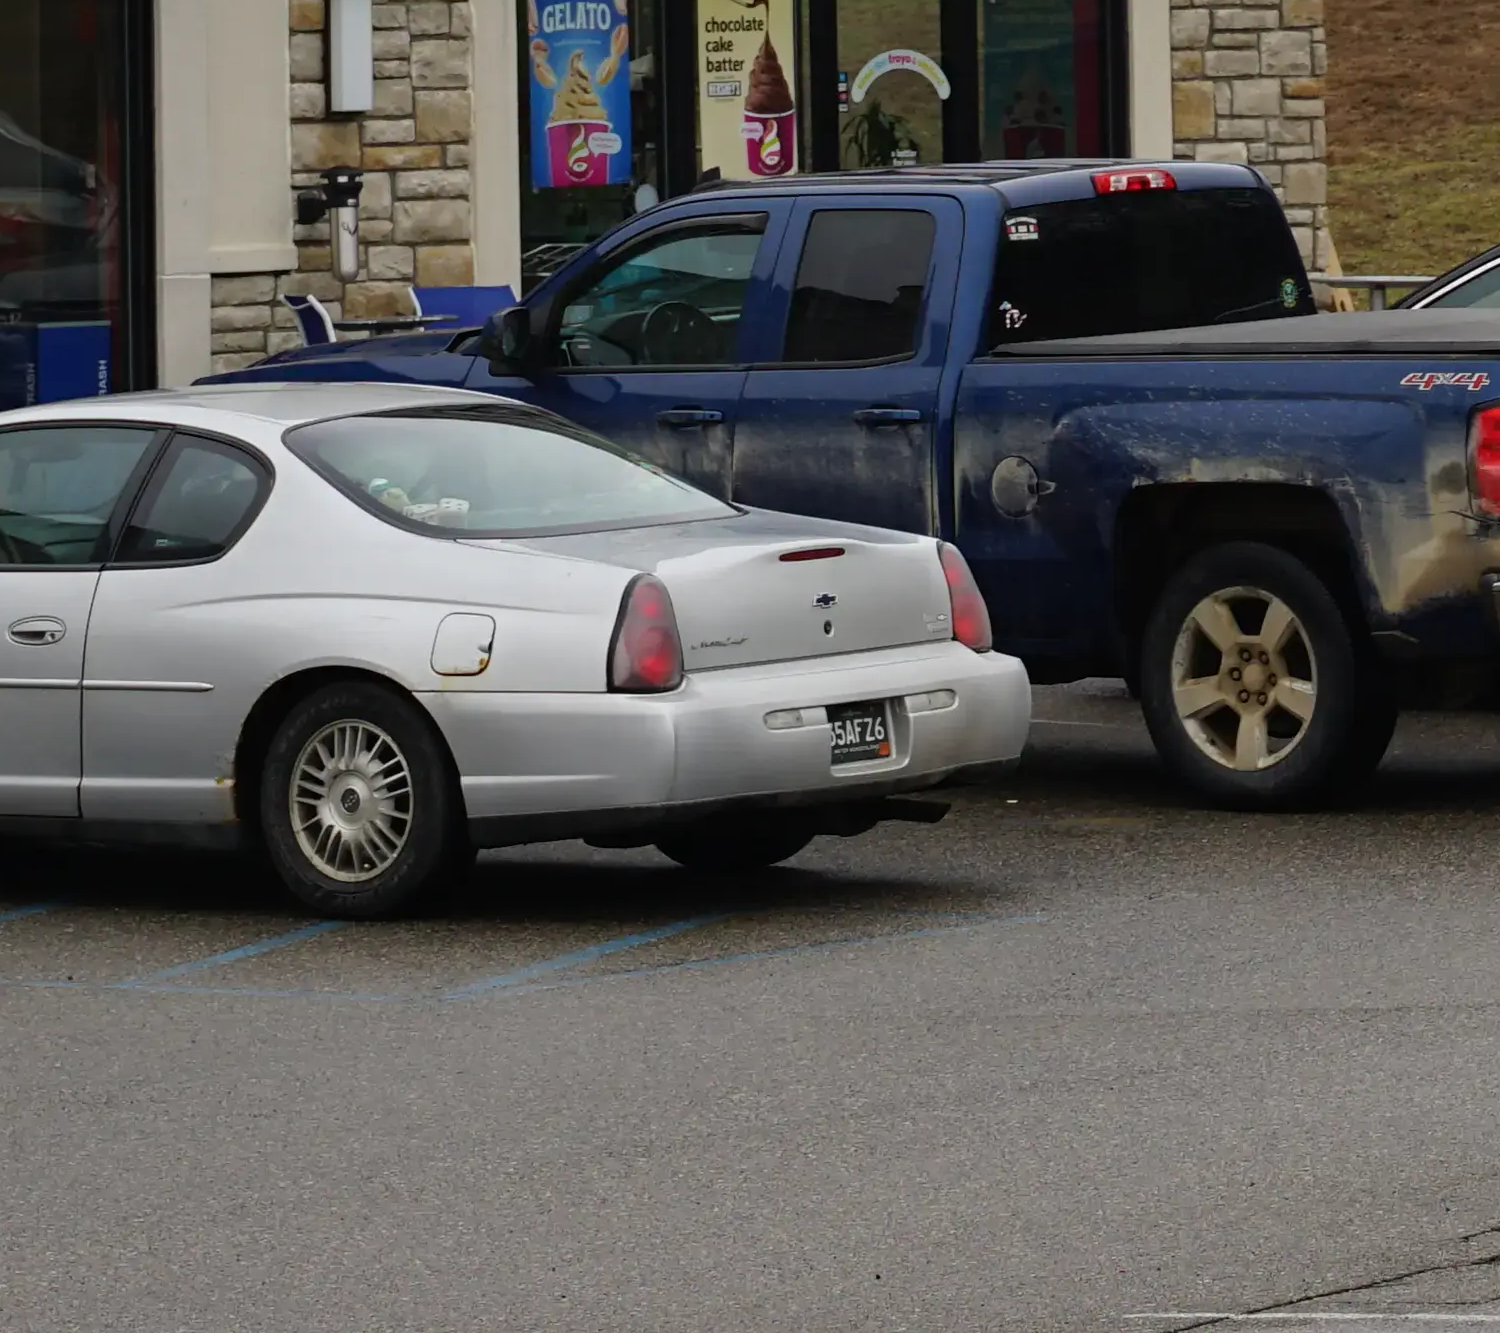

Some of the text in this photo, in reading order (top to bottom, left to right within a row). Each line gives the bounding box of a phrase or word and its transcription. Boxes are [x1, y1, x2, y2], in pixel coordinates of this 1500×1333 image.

[542, 1, 611, 33] GELATO
[705, 14, 765, 34] chocolate
[705, 36, 734, 53] cake
[706, 56, 745, 73] batter
